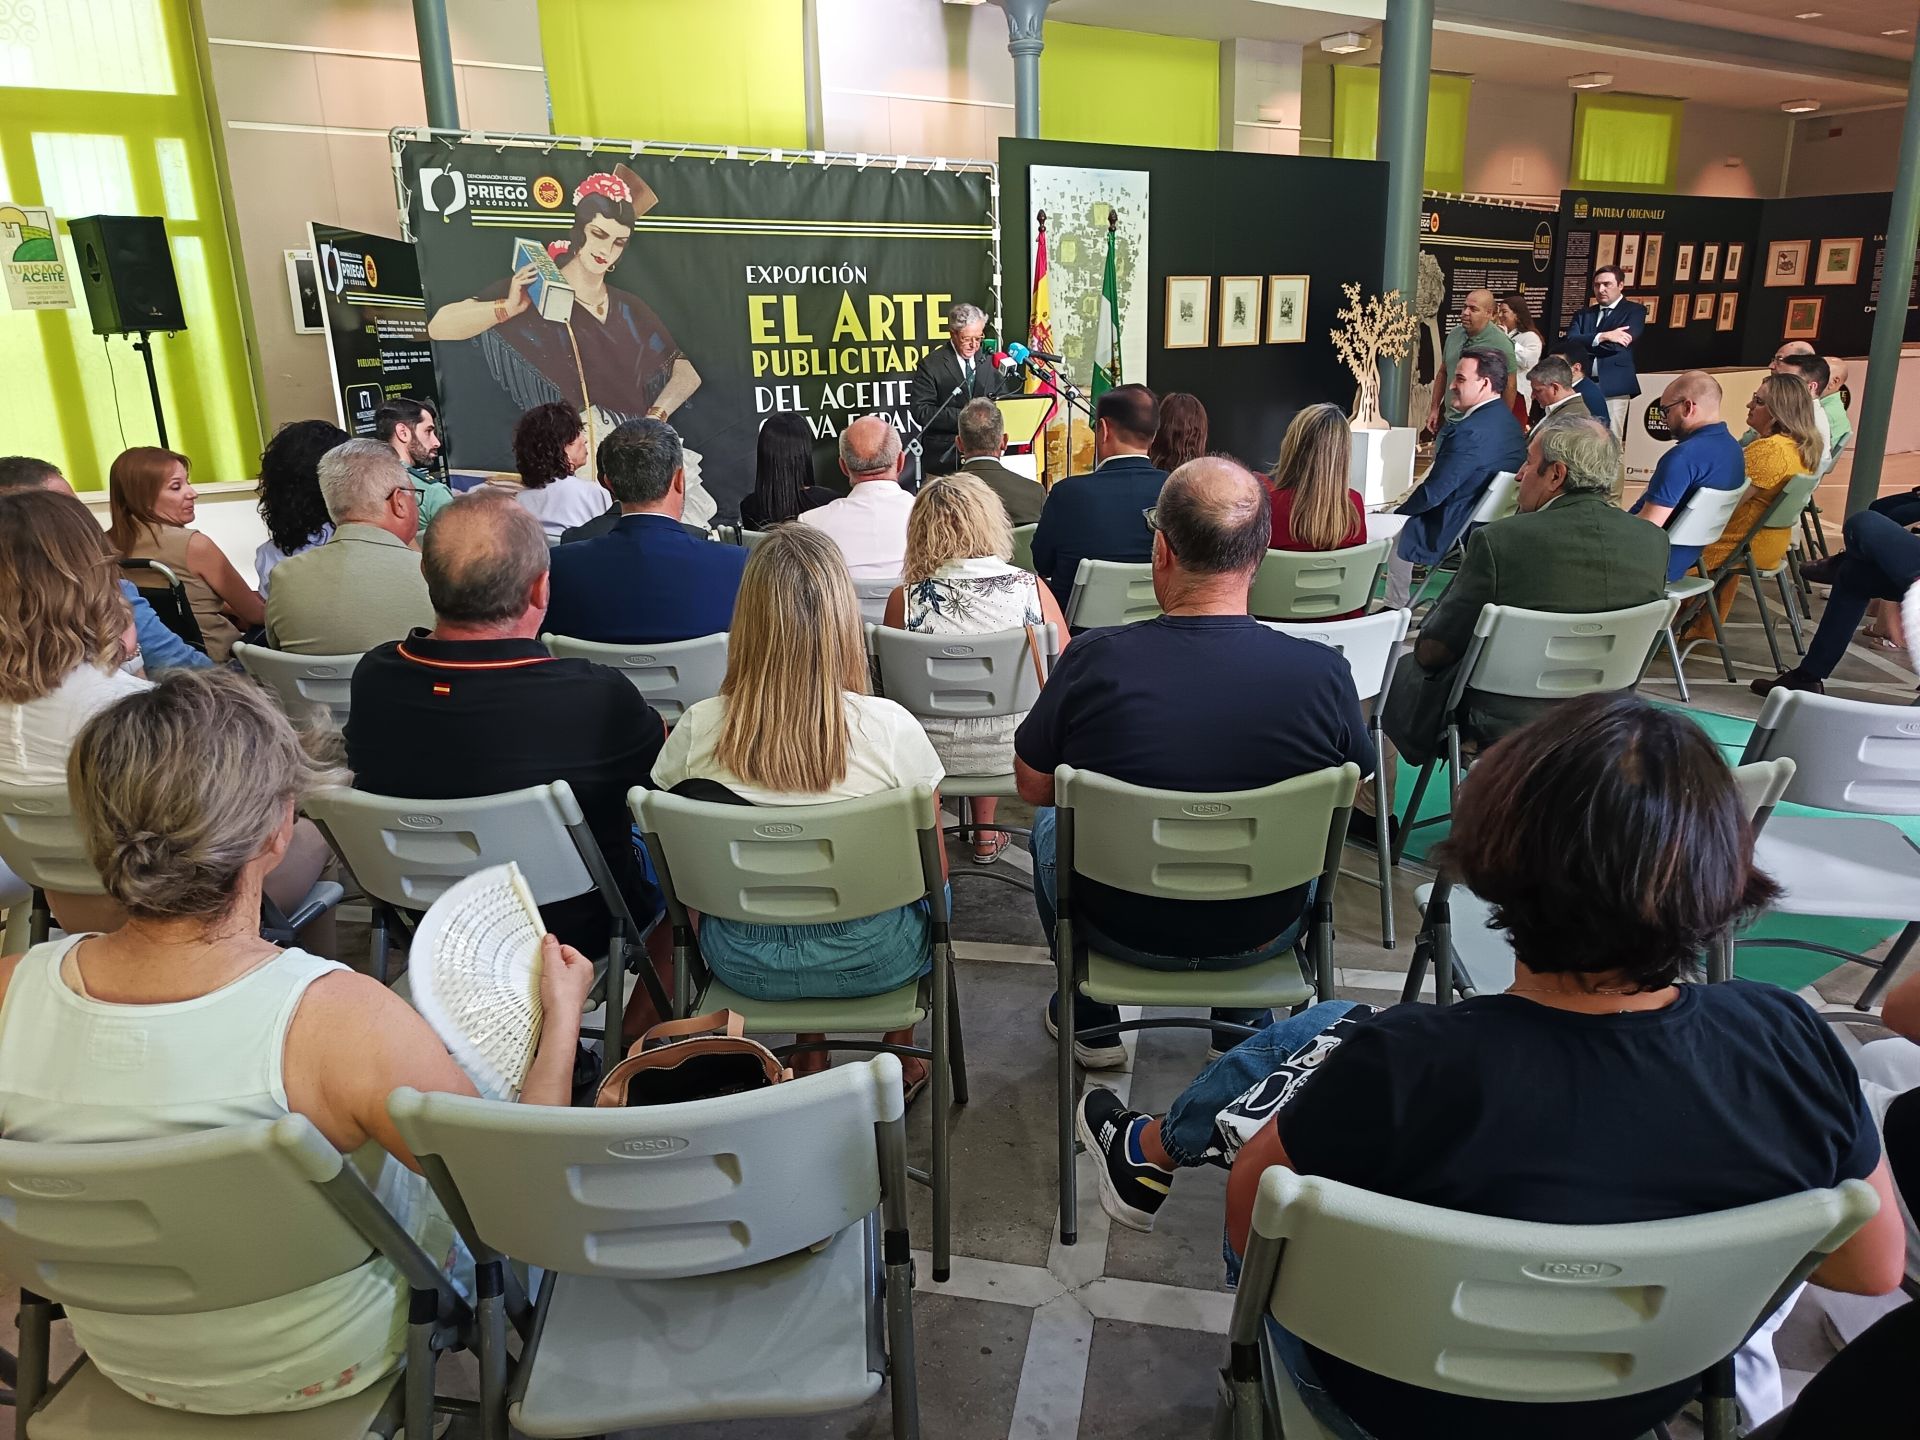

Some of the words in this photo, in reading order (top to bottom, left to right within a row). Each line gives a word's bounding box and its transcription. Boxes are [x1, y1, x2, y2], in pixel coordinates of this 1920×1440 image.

[467, 184, 528, 200] PRIEGO
[485, 199, 529, 208] CÓRDOBA
[1626, 208, 1666, 220] ORIGINALES
[8, 264, 63, 275] TURISMO
[745, 261, 867, 285] EXPOSICIÓN
[22, 273, 65, 282] ACEITE
[747, 294, 814, 344] EL
[831, 289, 952, 343] ARTE
[754, 384, 810, 414] DEL
[819, 379, 913, 410] ACEITE
[1192, 802, 1223, 812] resol
[764, 824, 794, 833] resol
[624, 1137, 674, 1151] resol
[1541, 1262, 1604, 1273] resol
